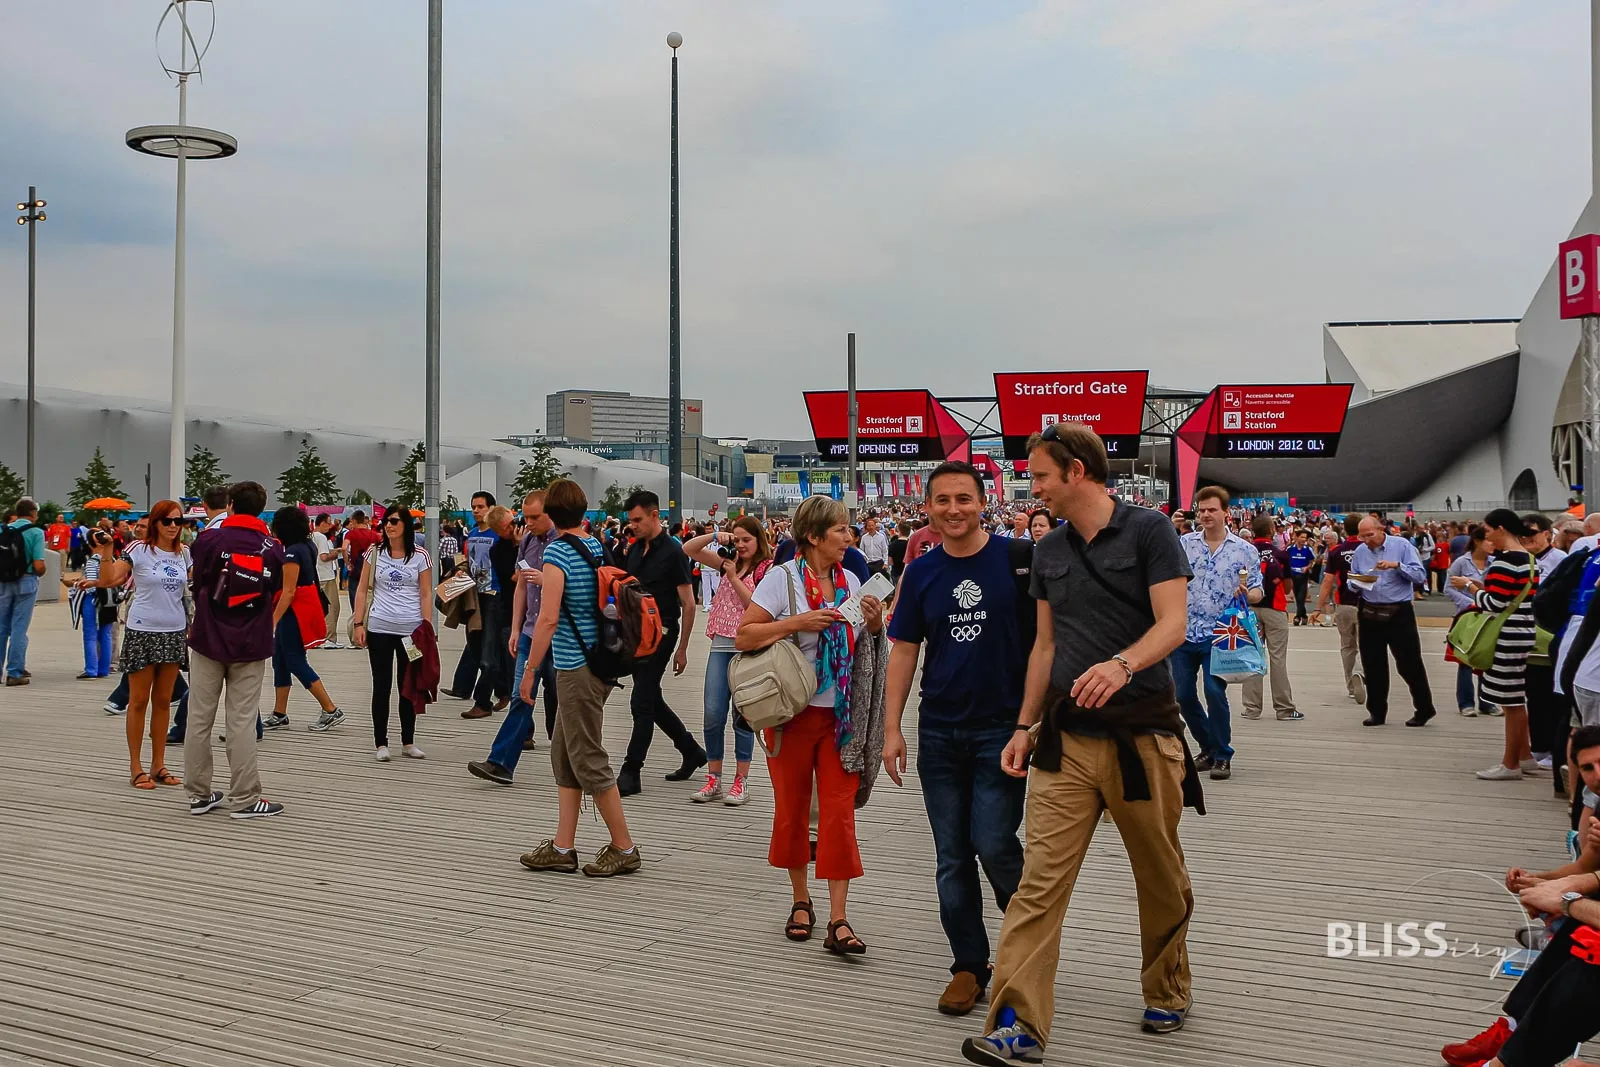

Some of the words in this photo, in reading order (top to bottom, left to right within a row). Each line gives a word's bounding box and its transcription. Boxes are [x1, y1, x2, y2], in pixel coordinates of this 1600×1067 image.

[1566, 250, 1586, 297] B
[1014, 381, 1084, 396] Stratford
[1090, 381, 1128, 394] Gate
[866, 416, 903, 424] Stratford
[1062, 413, 1101, 421] Stratford
[590, 445, 612, 453] Lewis
[858, 444, 896, 454] OPENING
[1238, 440, 1274, 450] LONDON
[1278, 440, 1303, 450] 2012
[948, 613, 972, 623] TEAM
[974, 610, 987, 620] GB
